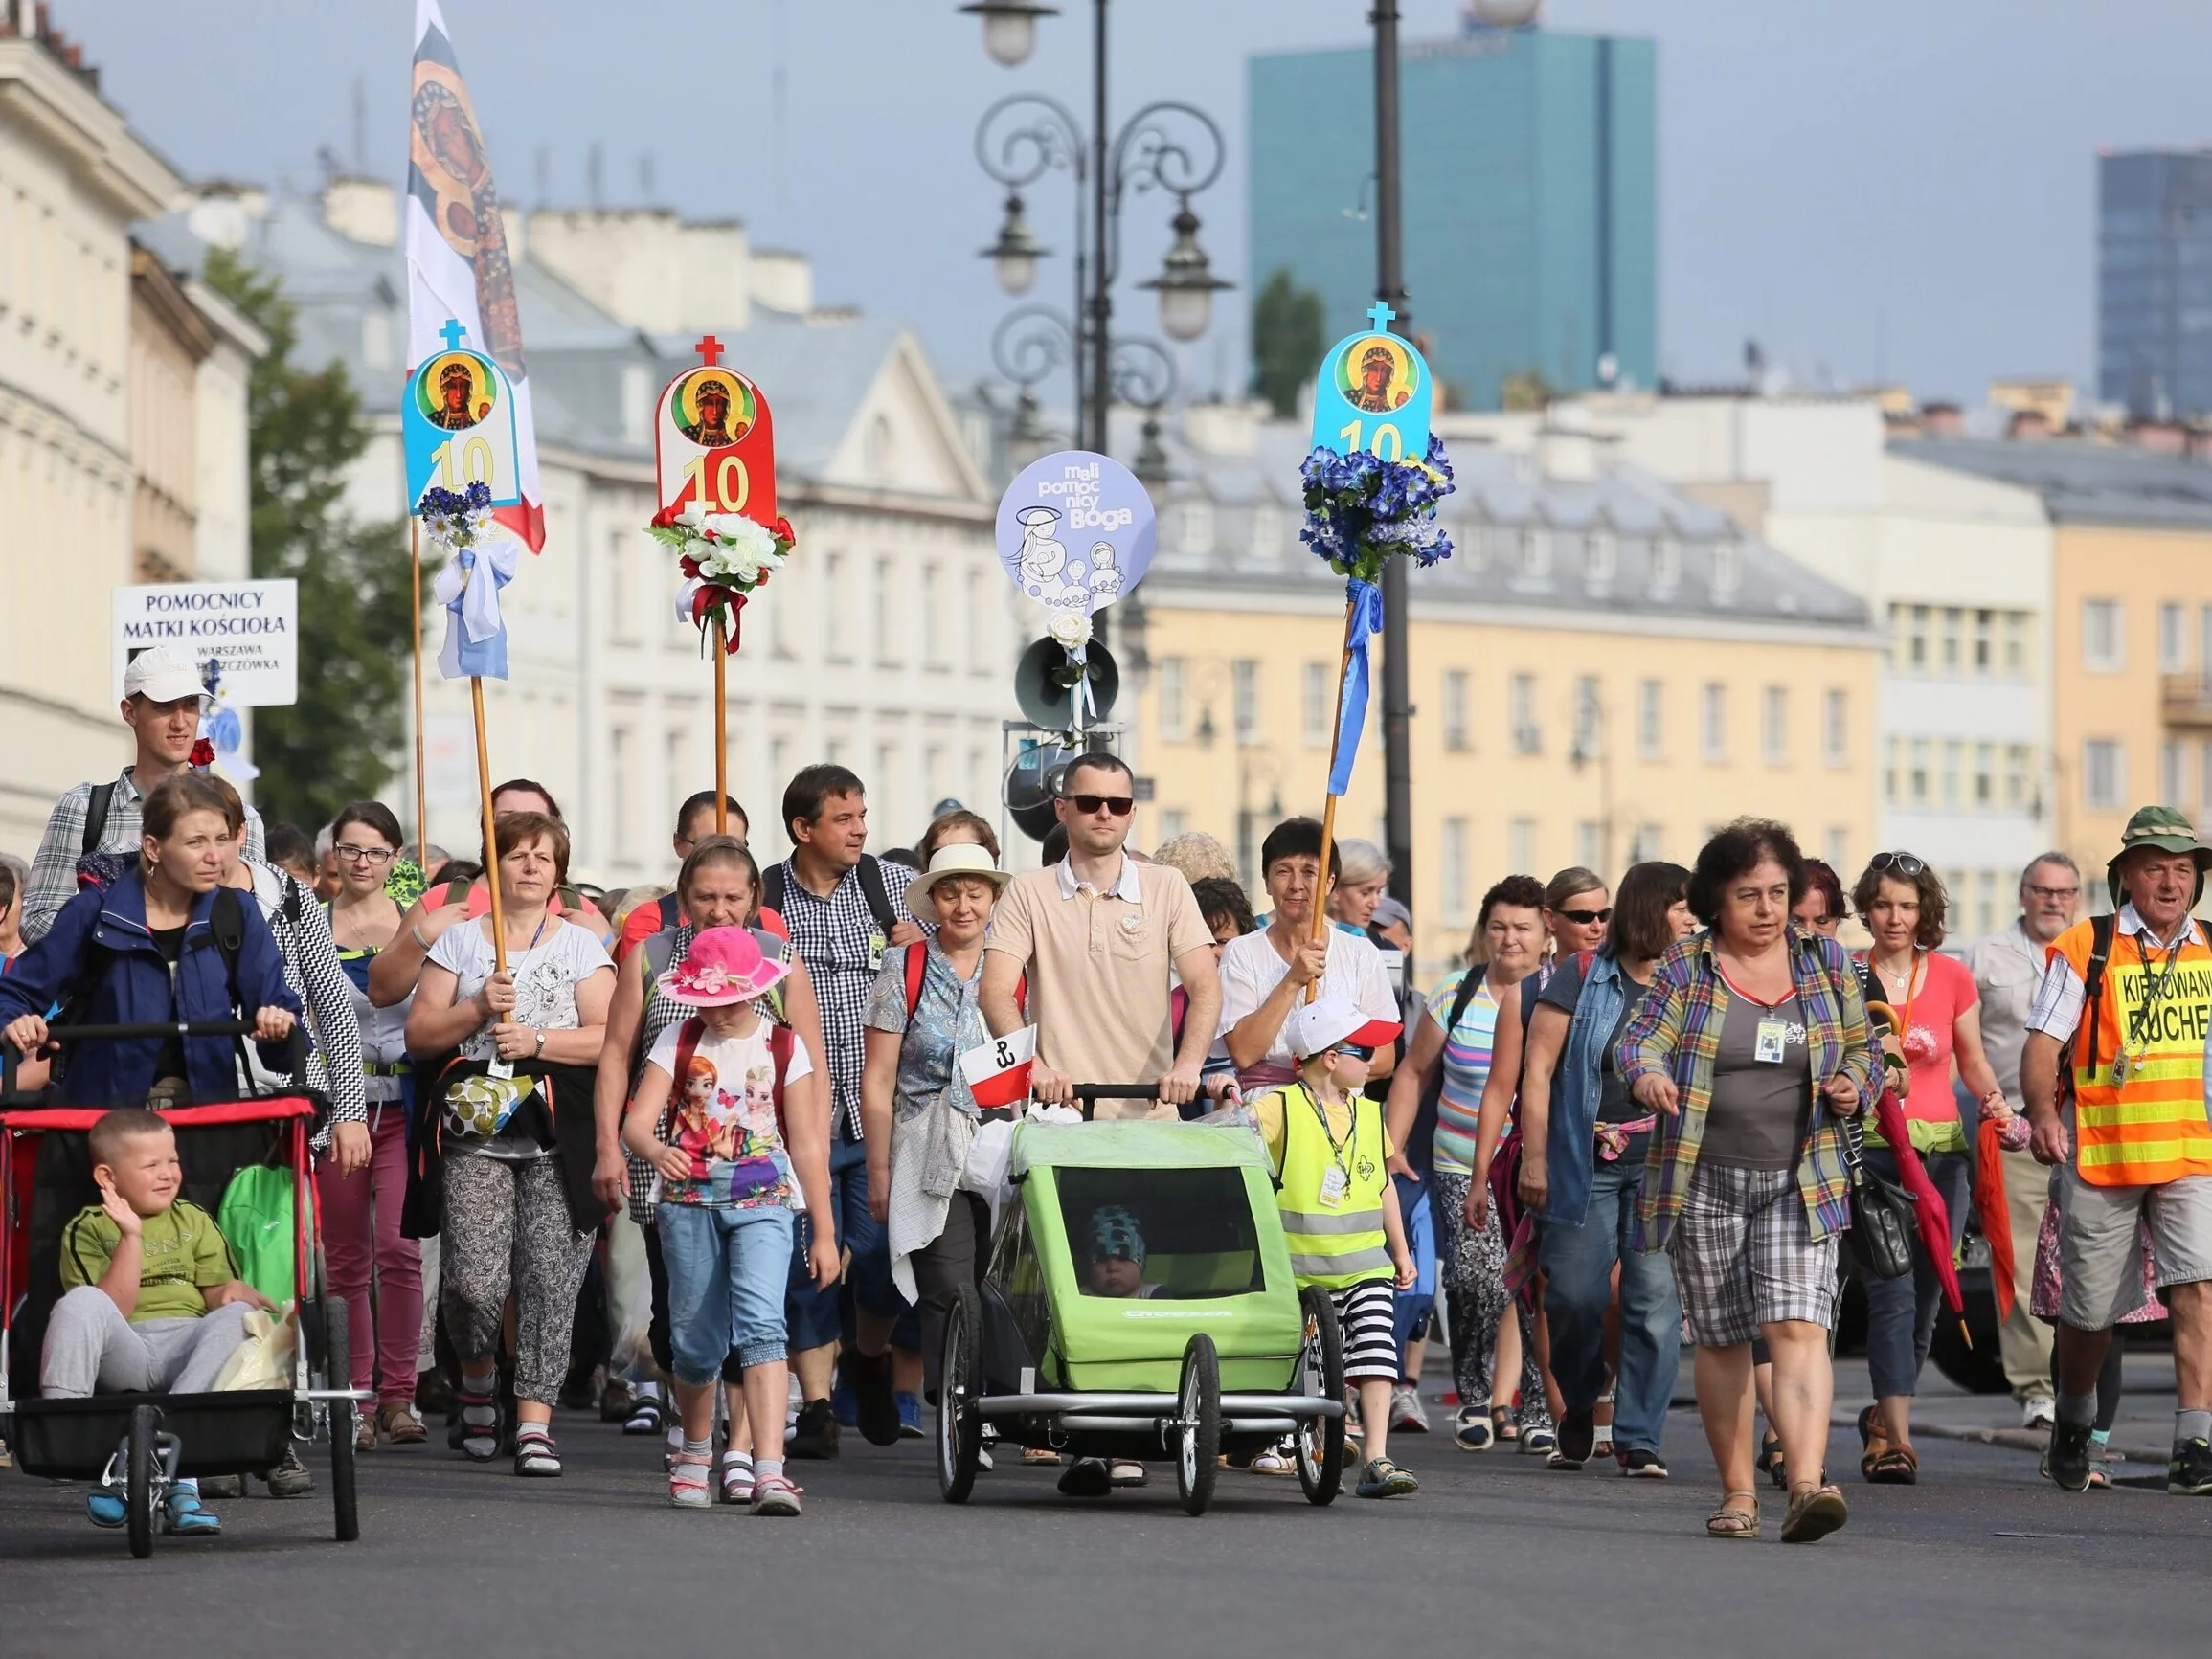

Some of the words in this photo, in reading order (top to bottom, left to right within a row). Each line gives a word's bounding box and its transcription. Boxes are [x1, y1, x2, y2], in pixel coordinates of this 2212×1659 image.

[1340, 419, 1402, 462] 10
[431, 437, 494, 492] 10
[1064, 462, 1099, 481] mali
[684, 455, 750, 512] 10
[1038, 480, 1100, 498] pomoc
[1065, 493, 1100, 511] nicy
[1070, 507, 1133, 532] Boga
[146, 592, 264, 612] POMOCNICY
[123, 620, 183, 639] MATKI
[190, 614, 285, 636] KOŚCIOŁA
[197, 644, 263, 657] WARSZAWA
